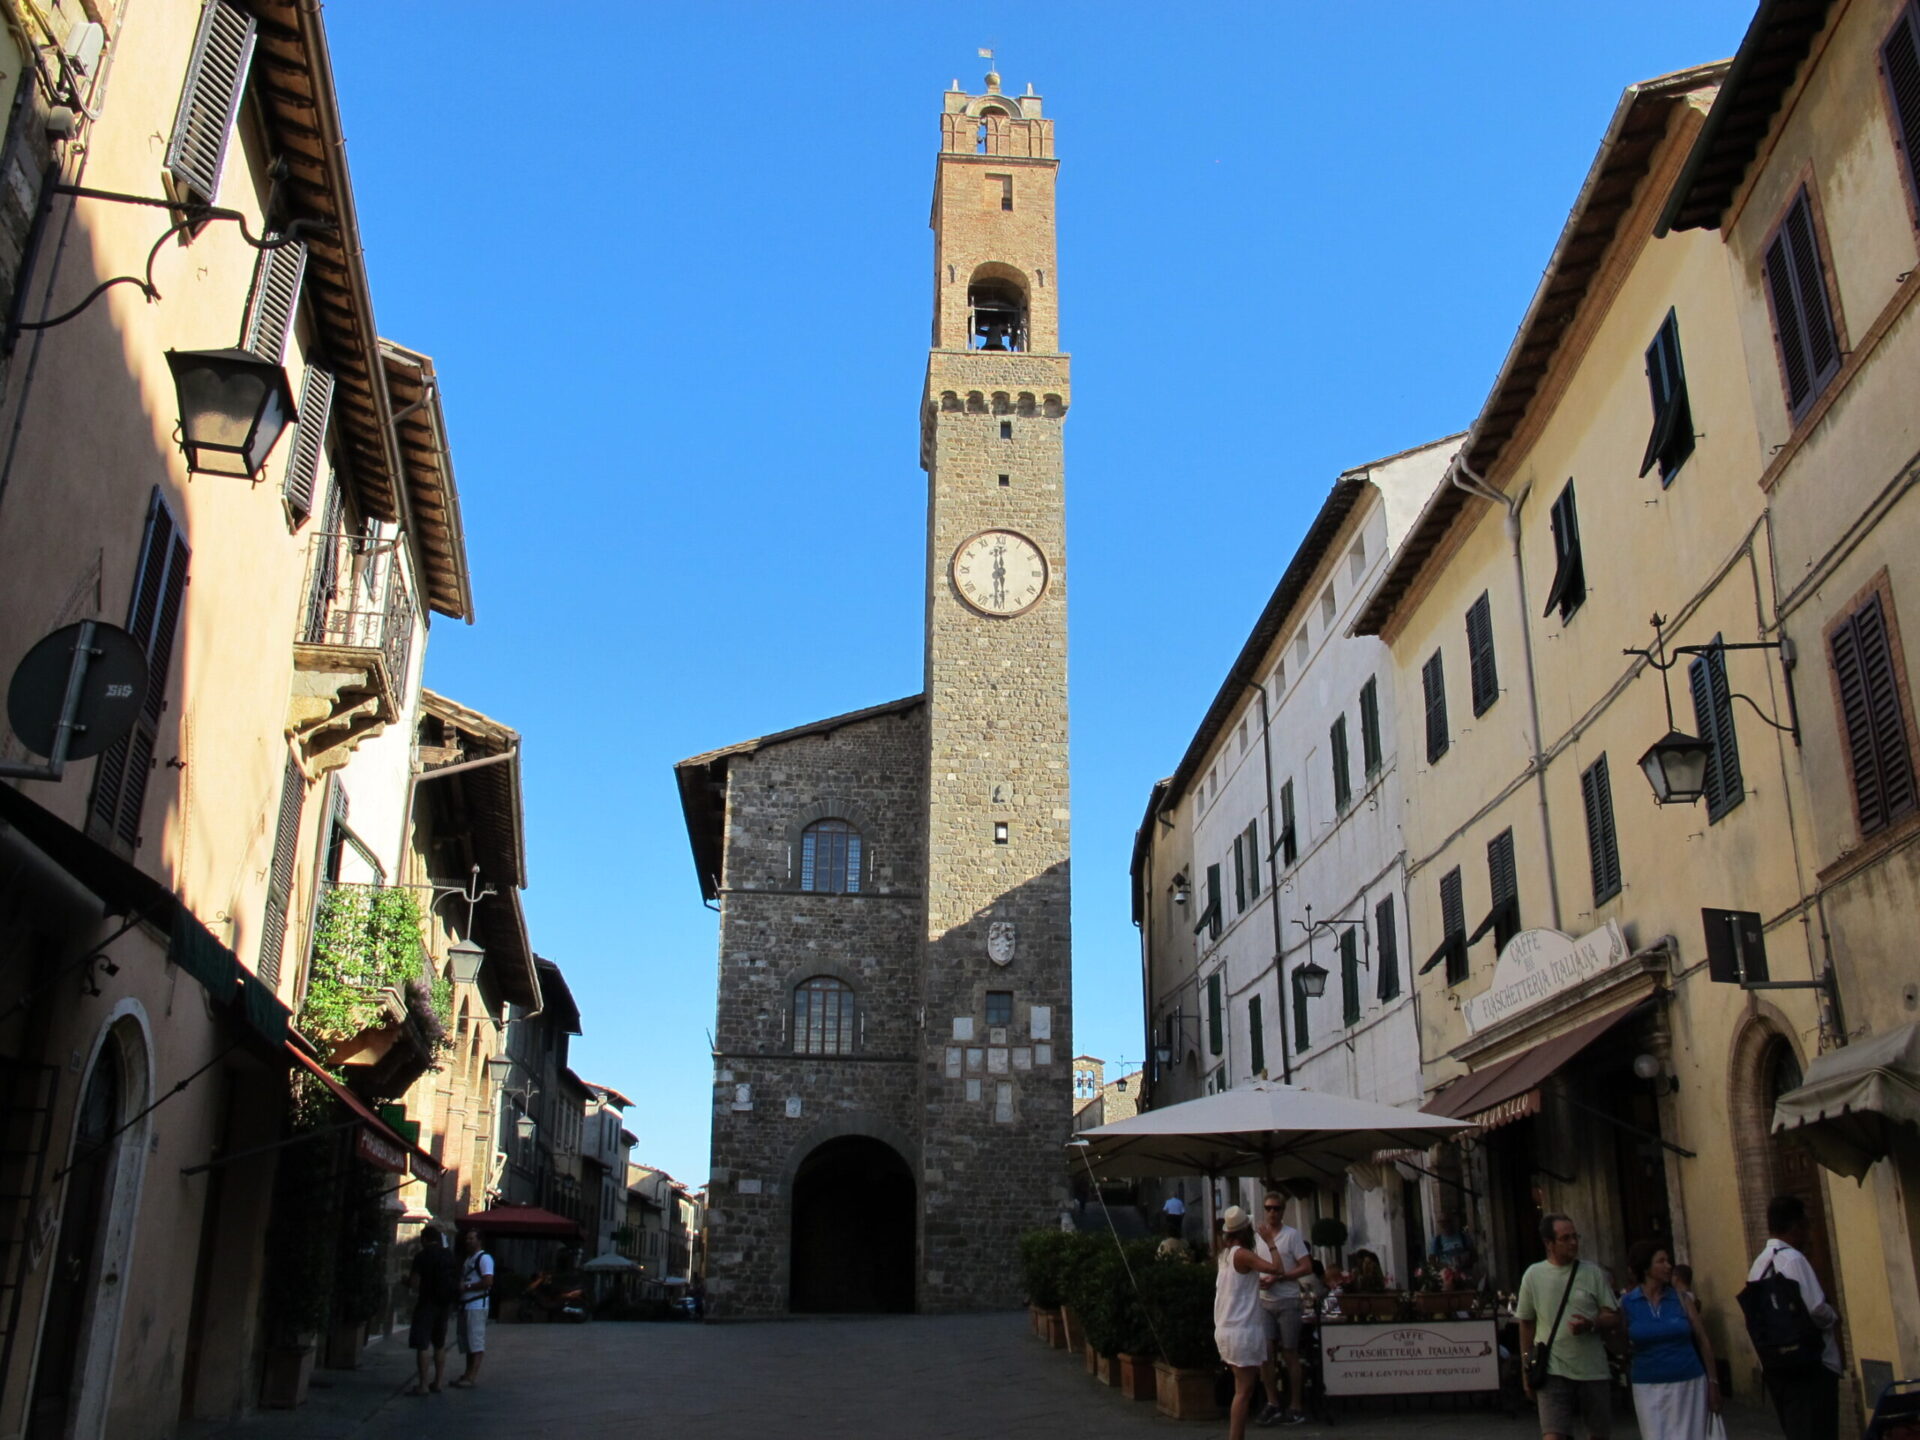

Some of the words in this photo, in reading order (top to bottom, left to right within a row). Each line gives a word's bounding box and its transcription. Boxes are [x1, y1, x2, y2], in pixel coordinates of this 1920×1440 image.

[1482, 968, 1551, 1019] FIASCHETTERIA
[1549, 943, 1600, 985] ITALIANA
[1350, 1347, 1422, 1358] FIASCHETTERIA
[1428, 1346, 1471, 1356] ITALIANA
